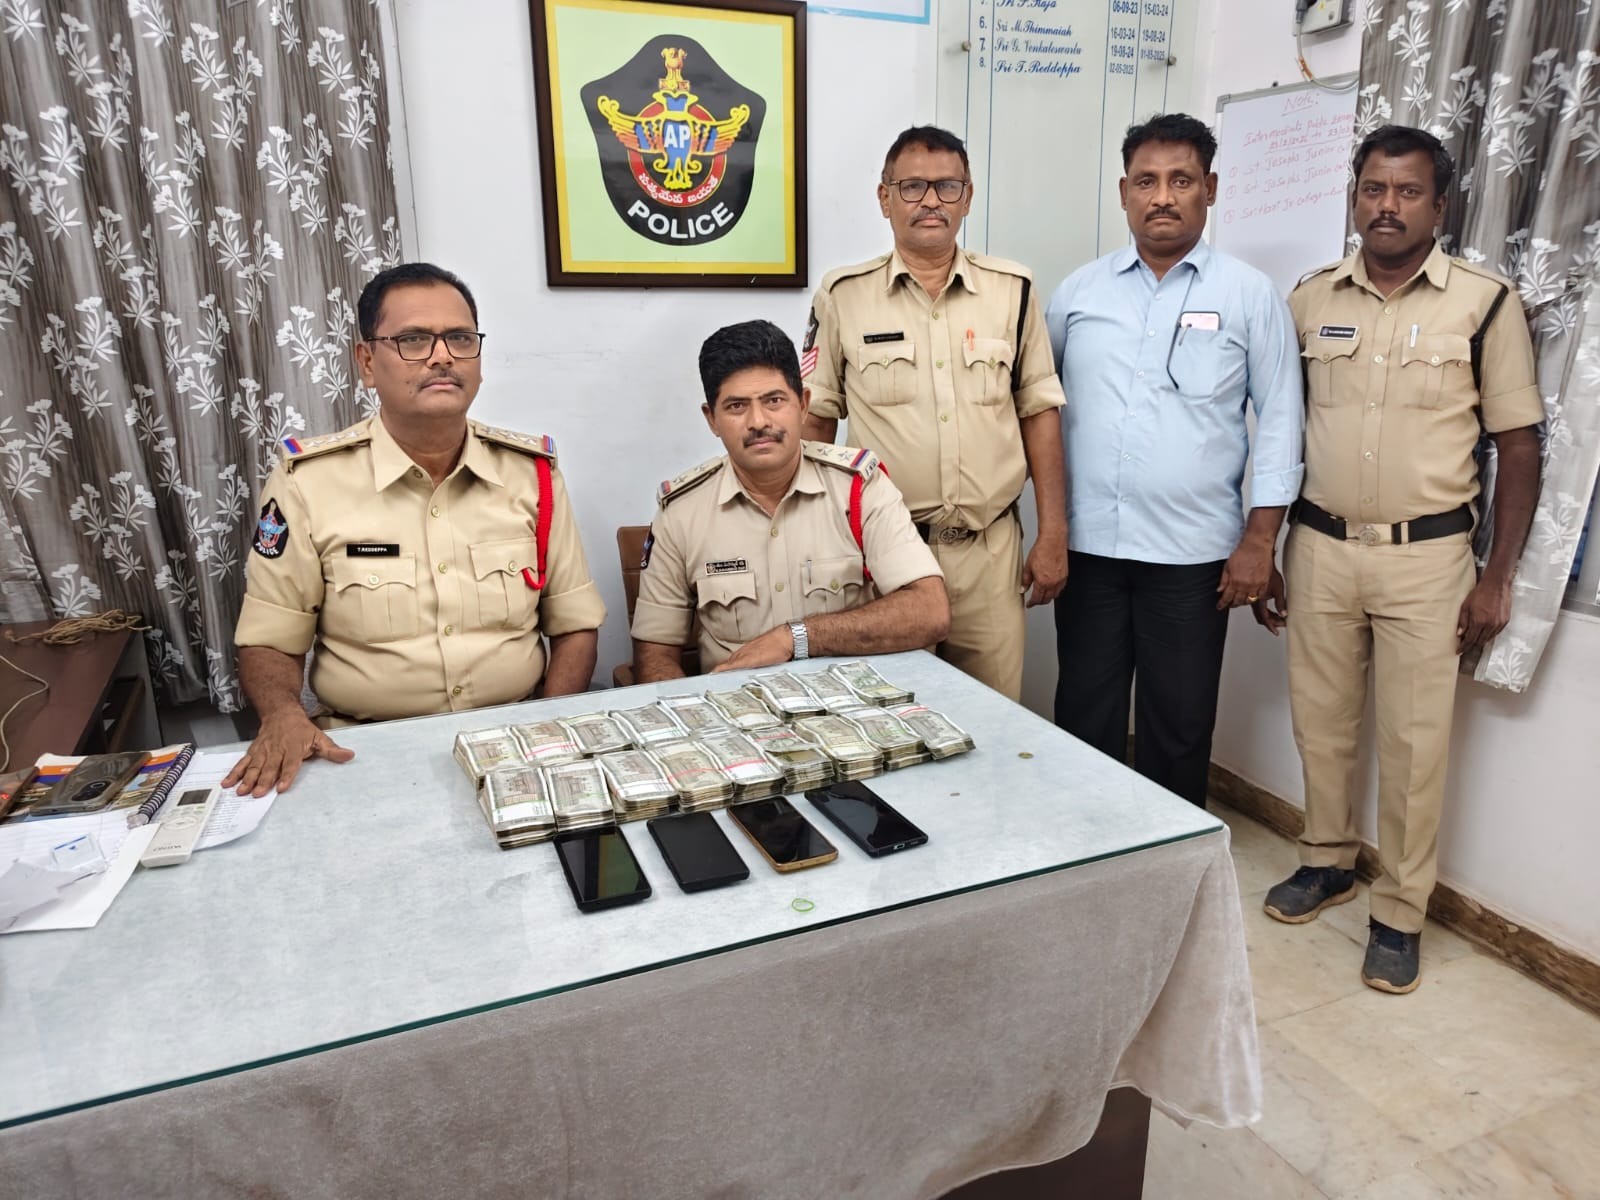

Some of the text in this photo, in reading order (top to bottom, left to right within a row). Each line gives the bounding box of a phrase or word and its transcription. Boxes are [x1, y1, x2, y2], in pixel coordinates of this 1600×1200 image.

[1144, 3, 1168, 16] 15-03-24
[979, 16, 987, 29] 6.
[996, 19, 1008, 32] Sri
[1111, 27, 1135, 40] 16-03-24
[995, 37, 1008, 52] Sri
[979, 56, 986, 68] 8.
[994, 60, 1012, 73] Sri
[1015, 60, 1081, 78] T.Reddeppa
[664, 124, 691, 149] AP
[627, 199, 735, 239] POLICE
